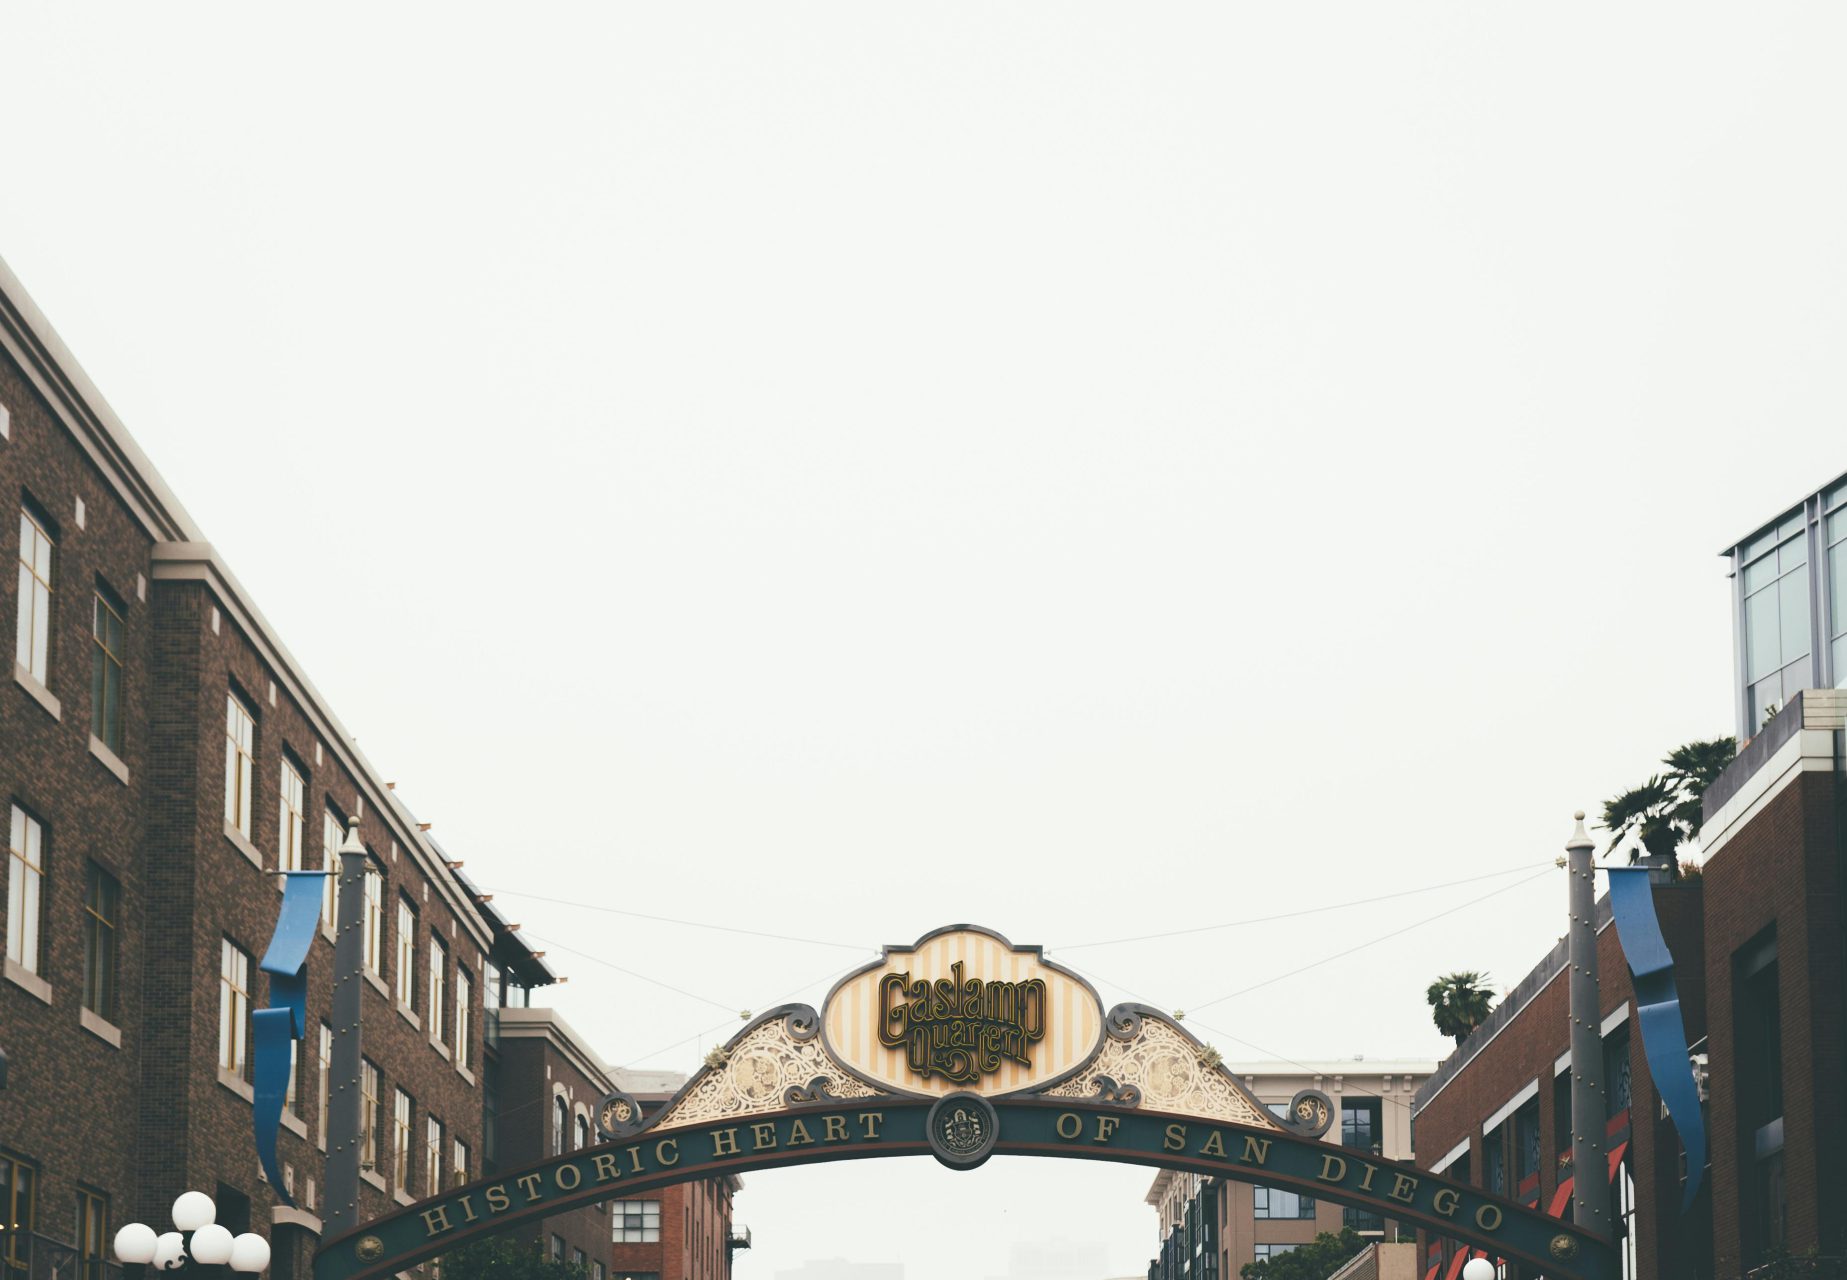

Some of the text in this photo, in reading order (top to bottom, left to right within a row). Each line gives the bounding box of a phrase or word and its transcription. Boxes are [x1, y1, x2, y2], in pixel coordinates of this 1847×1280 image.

[878, 960, 1047, 1048] Gaslamp
[905, 1019, 1032, 1082] Quarter
[419, 1138, 681, 1238] HISTORIC
[710, 1111, 885, 1159] HEART
[1056, 1111, 1121, 1143] OF
[1163, 1122, 1273, 1166] SAN
[1316, 1153, 1503, 1232] DIEGO
